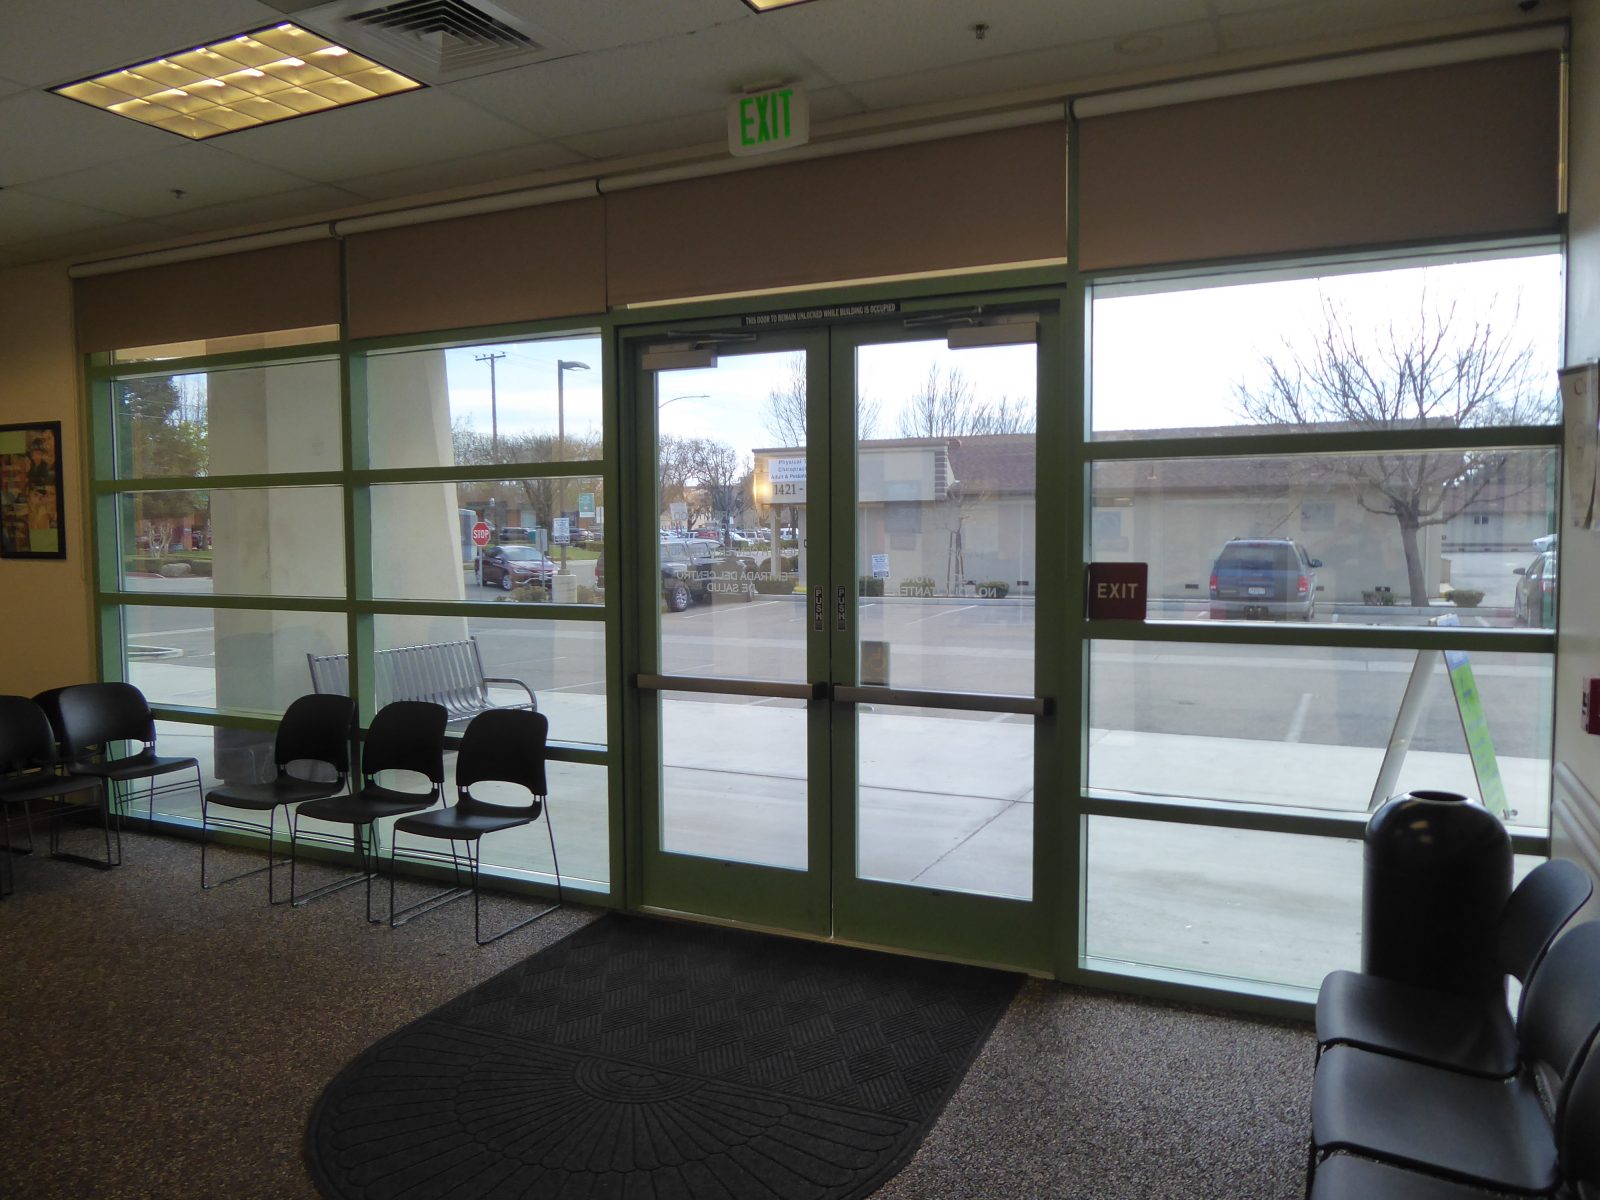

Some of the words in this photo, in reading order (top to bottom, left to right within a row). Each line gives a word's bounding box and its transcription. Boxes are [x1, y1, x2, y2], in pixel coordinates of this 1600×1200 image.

[739, 87, 793, 147] EXIT
[745, 316, 757, 326] THIS
[757, 315, 770, 325] DOOR
[771, 314, 778, 323] TO
[778, 312, 797, 323] REMAIN
[797, 310, 823, 321] UNLOCKED
[823, 308, 839, 318] WHILE
[840, 306, 864, 317] BUILDING
[864, 305, 870, 314] IS
[870, 303, 896, 313] OCCUPIED
[773, 483, 796, 495] 1421
[473, 529, 489, 539] STOP
[1097, 582, 1139, 599] EXIT
[815, 589, 823, 620] PUSH
[838, 589, 846, 620] PUSH
